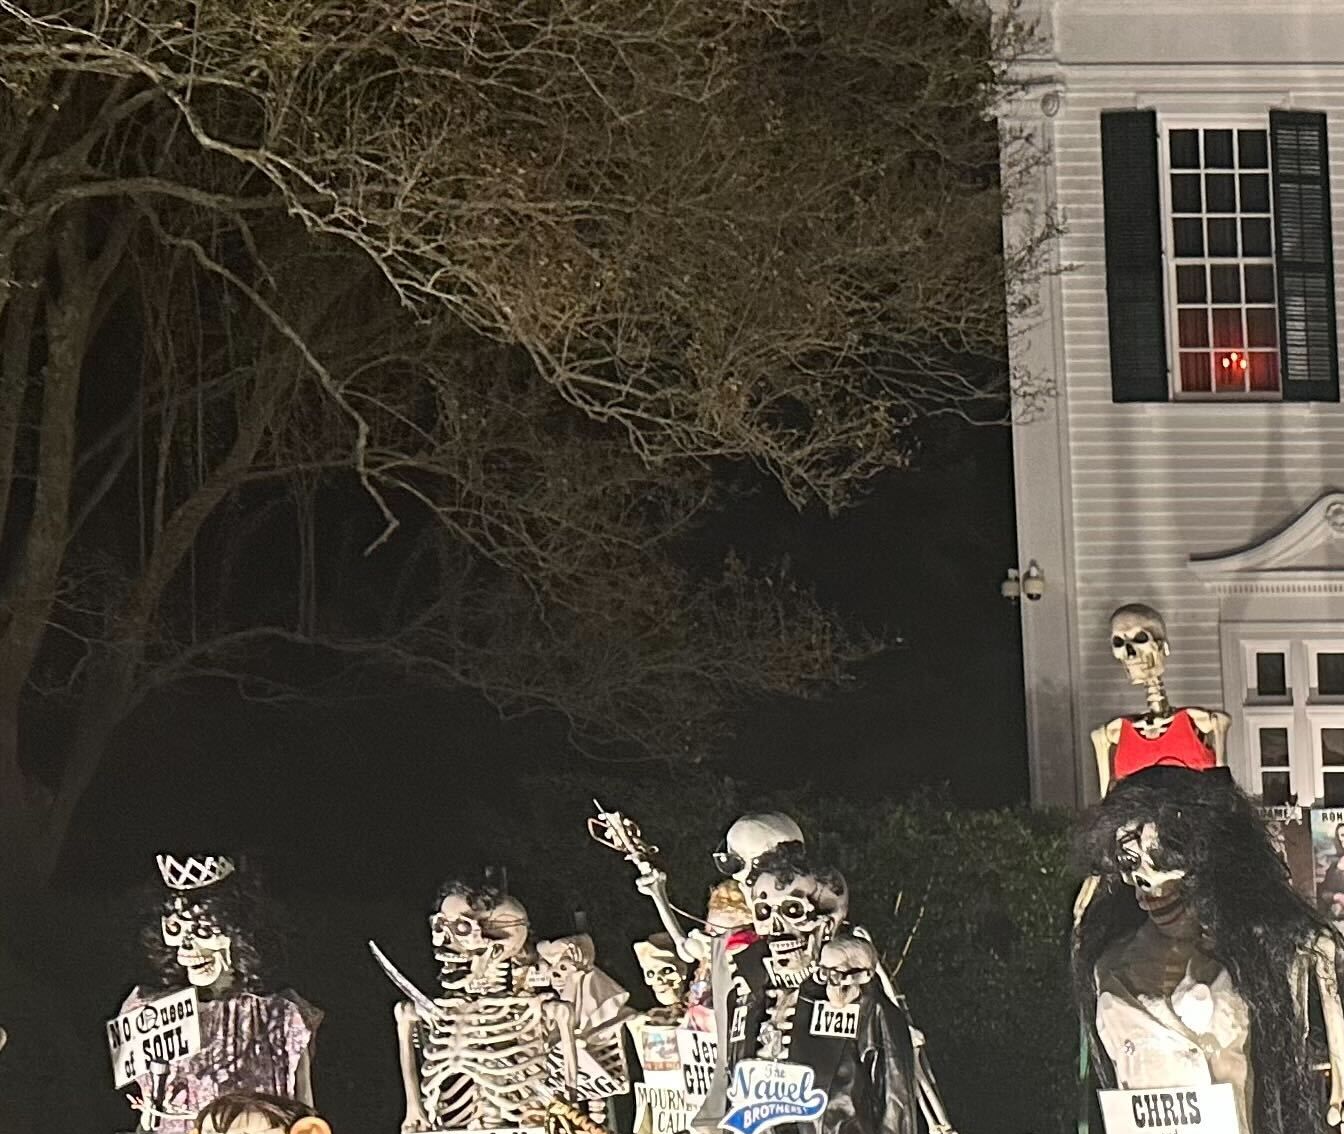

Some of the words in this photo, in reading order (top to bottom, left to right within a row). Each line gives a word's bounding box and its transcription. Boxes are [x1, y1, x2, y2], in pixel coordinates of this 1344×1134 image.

[135, 997, 195, 1034] Queen
[814, 1003, 856, 1035] Ivan
[142, 1029, 189, 1063] SOUL
[730, 1066, 812, 1104] Navel
[1131, 1091, 1202, 1128] CHRIS
